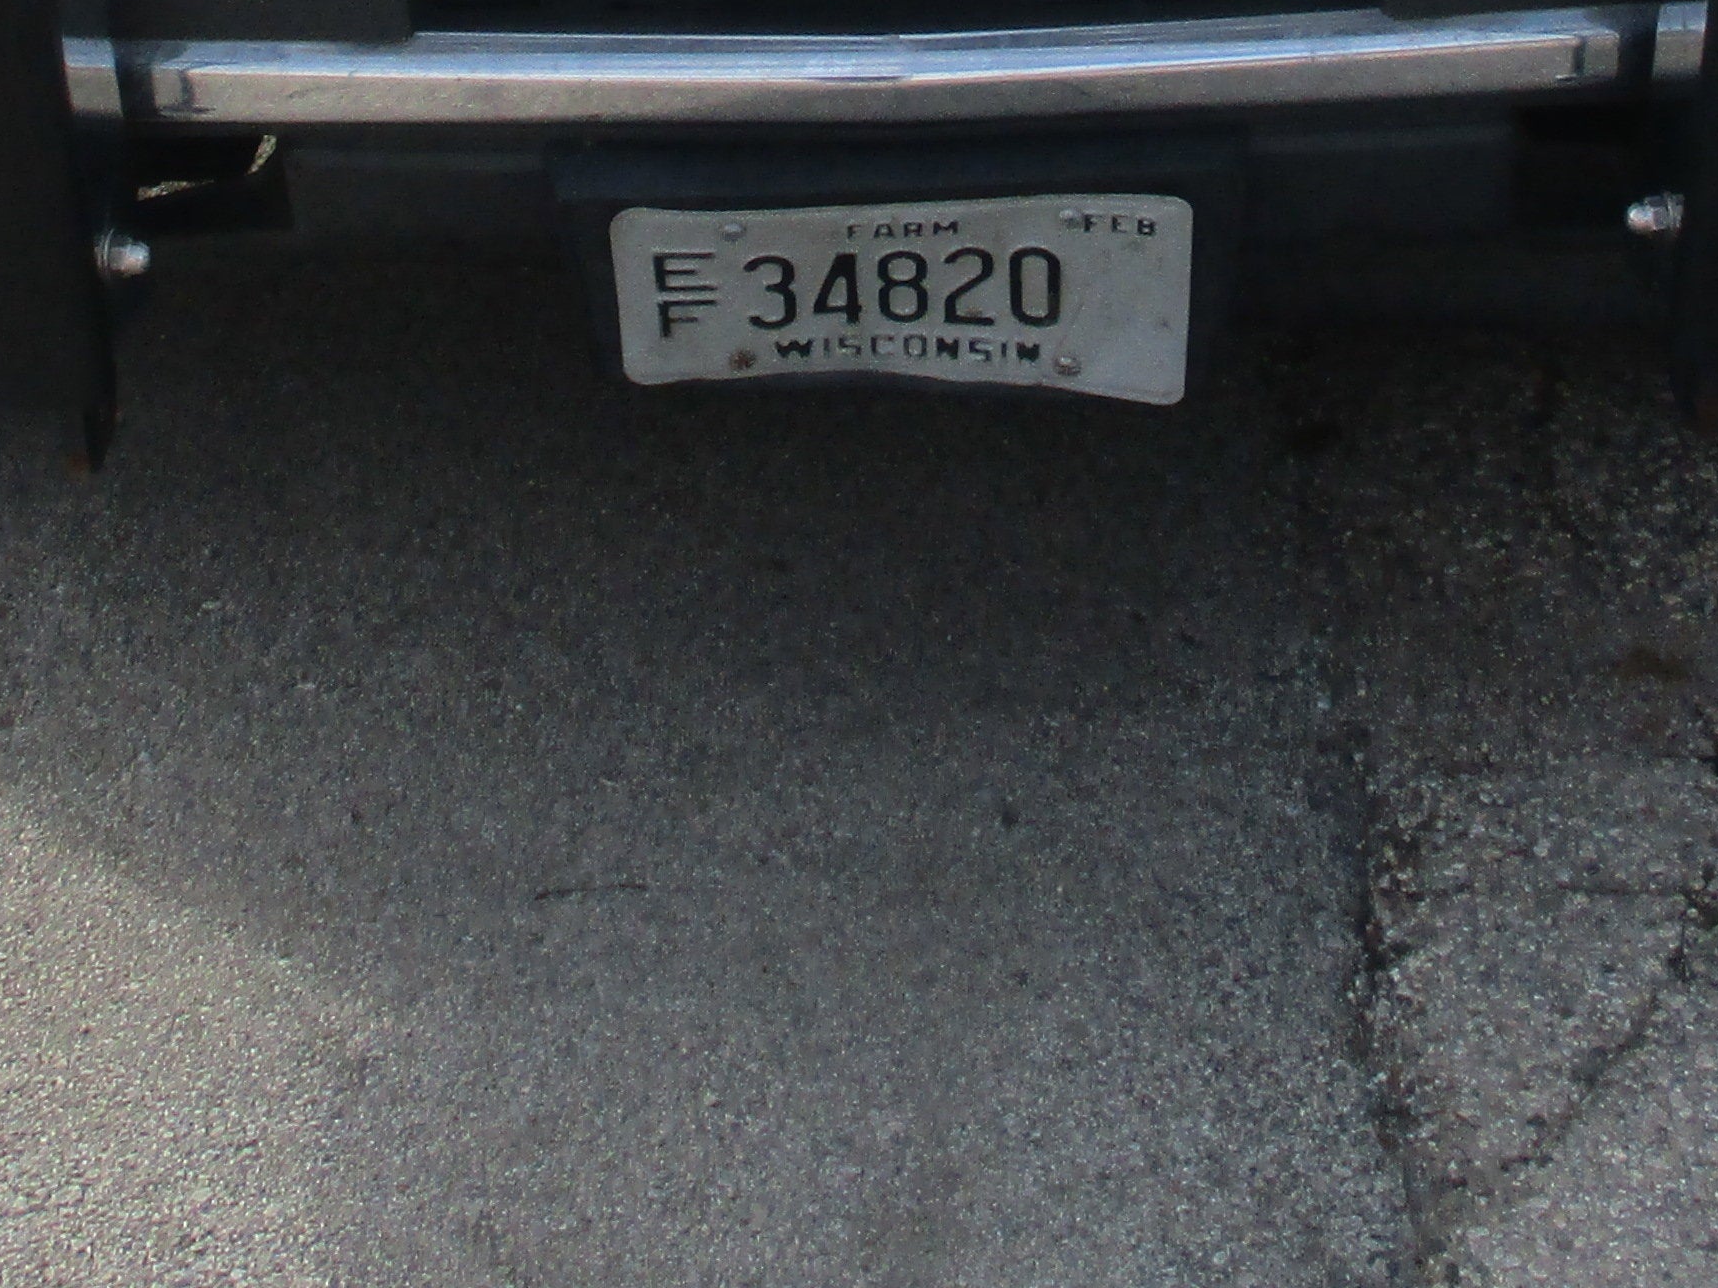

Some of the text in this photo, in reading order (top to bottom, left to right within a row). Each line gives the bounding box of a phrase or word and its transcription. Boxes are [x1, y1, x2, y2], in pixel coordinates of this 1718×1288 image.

[846, 212, 1157, 240] FARM FEB
[742, 245, 1062, 330] 34820
[773, 334, 1042, 362] WISCONSIN
